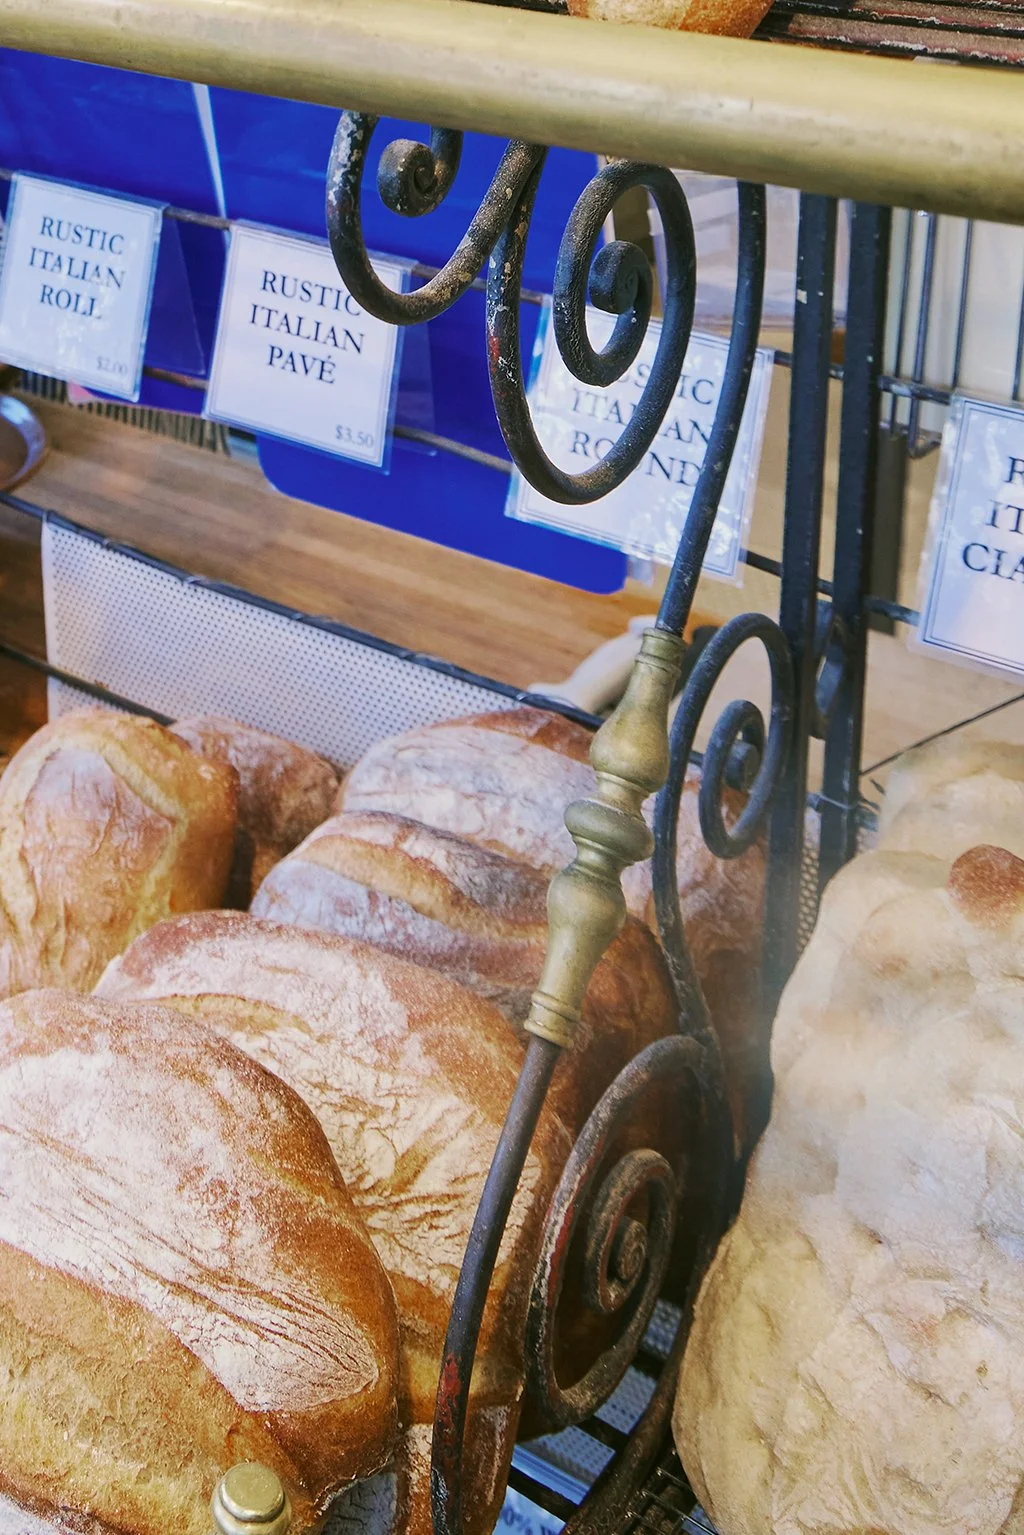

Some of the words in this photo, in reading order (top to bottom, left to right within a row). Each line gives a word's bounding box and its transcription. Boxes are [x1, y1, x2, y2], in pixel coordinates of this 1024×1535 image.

[40, 216, 125, 256] RUSTIC
[29, 246, 125, 289] ITALIAN
[39, 284, 102, 319] ROLL
[260, 269, 362, 316] RUSTIC
[248, 303, 366, 355] ITALIAN
[266, 344, 337, 385] PAVÉ
[335, 424, 375, 449] $3.50
[571, 387, 714, 445] ITAAN
[568, 429, 703, 488] ROND
